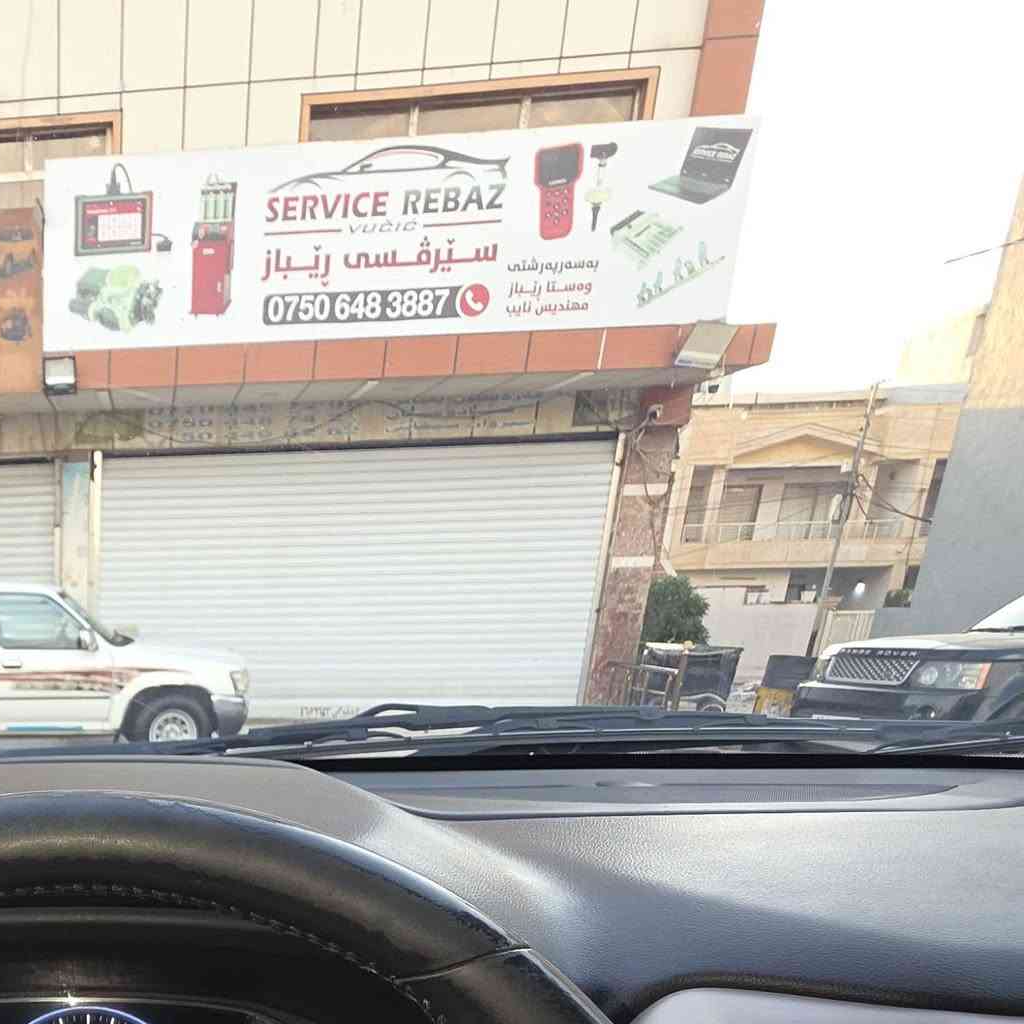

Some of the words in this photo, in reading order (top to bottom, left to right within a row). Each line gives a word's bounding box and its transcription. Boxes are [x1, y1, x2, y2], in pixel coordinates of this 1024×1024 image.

[265, 191, 389, 223] SERVICE
[402, 183, 506, 216] REBAZ
[267, 293, 330, 323] 0750
[334, 291, 381, 320] 648
[386, 288, 450, 318] 3887
